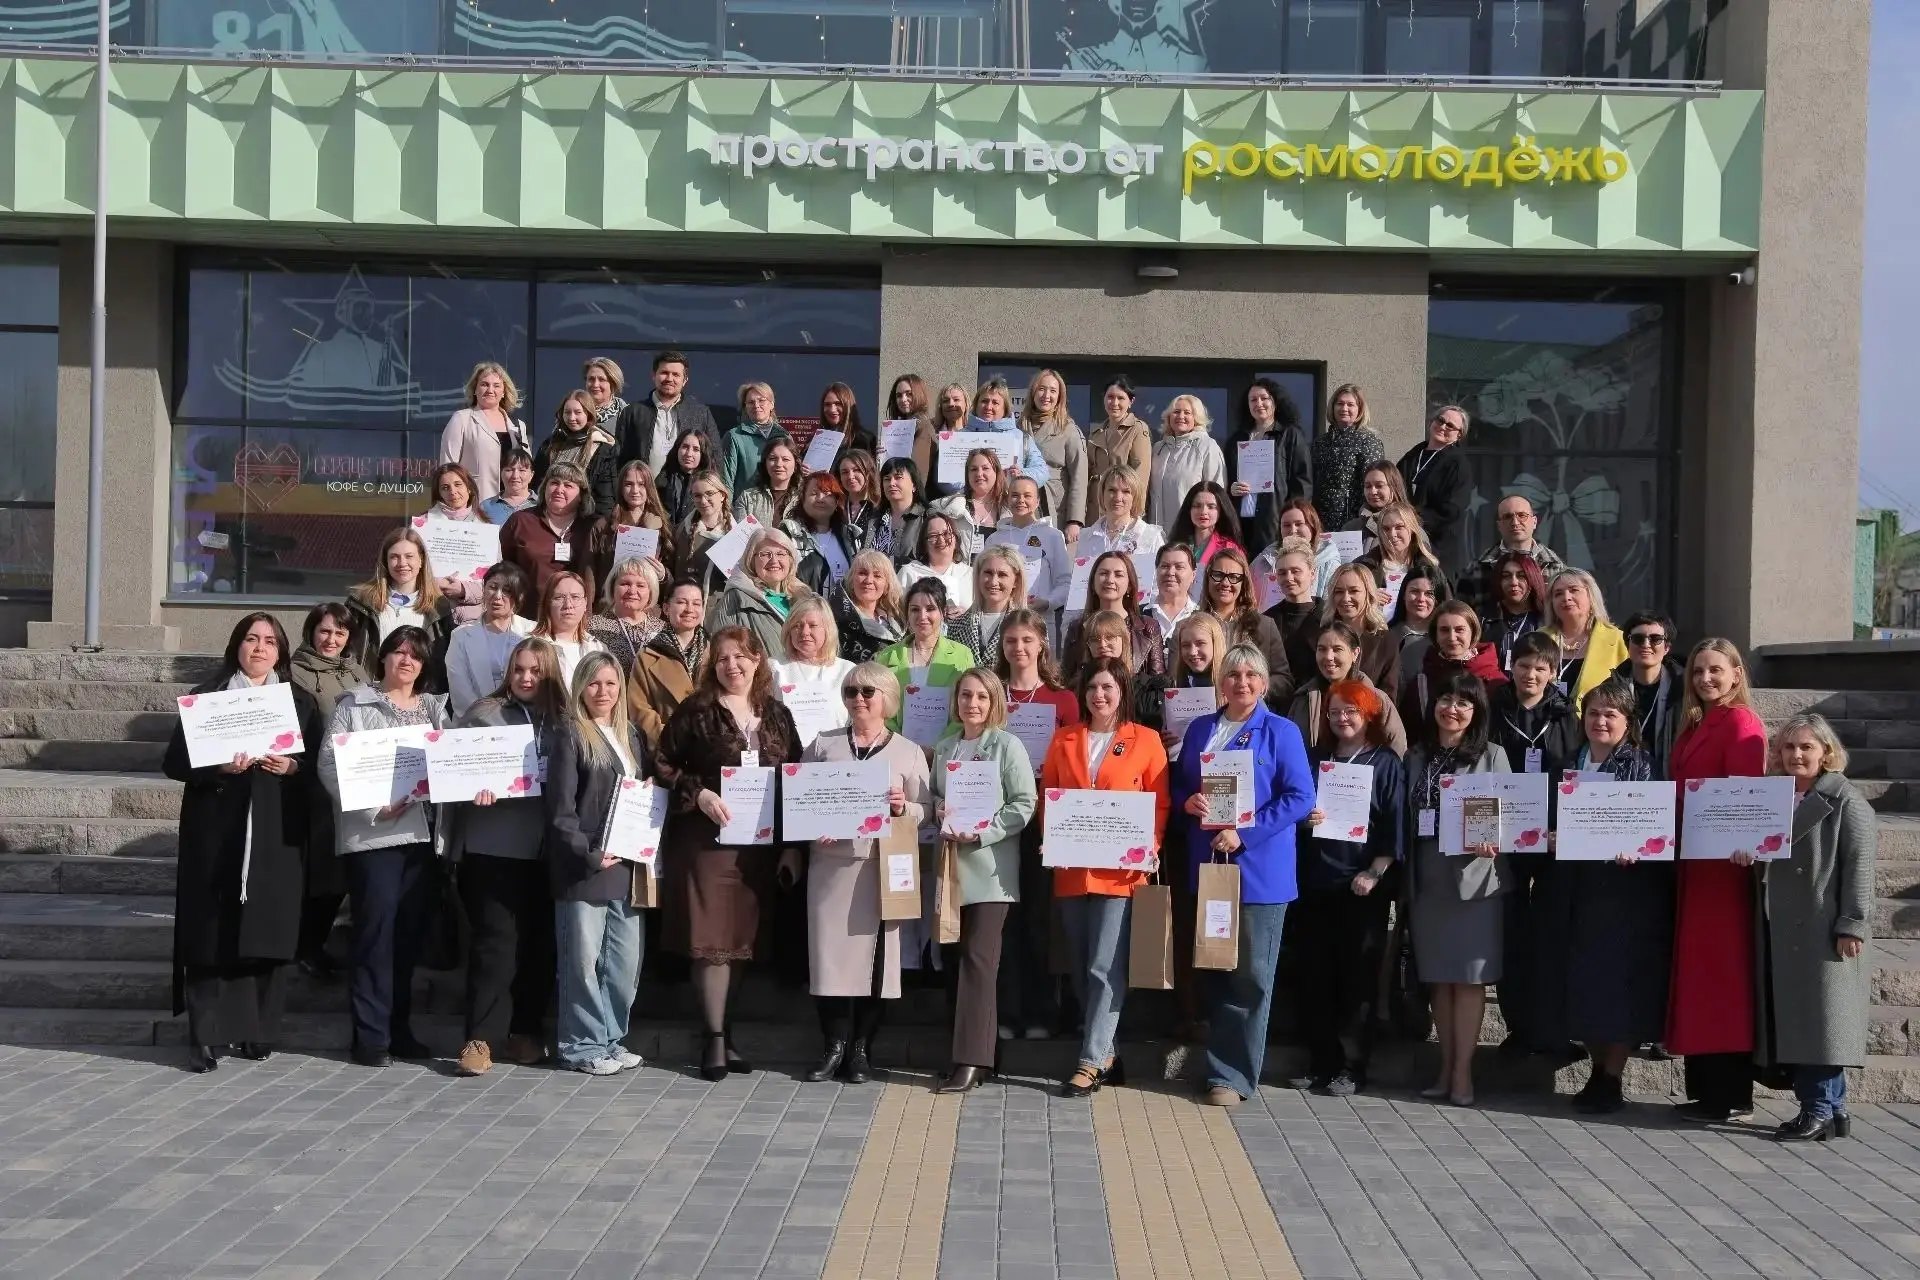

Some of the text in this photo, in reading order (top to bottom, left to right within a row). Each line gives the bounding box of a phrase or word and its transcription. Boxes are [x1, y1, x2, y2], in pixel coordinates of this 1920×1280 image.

[710, 134, 1628, 196] пространство от росмолодёжь
[327, 481, 424, 495] КОФЕ С ДУШОЙ
